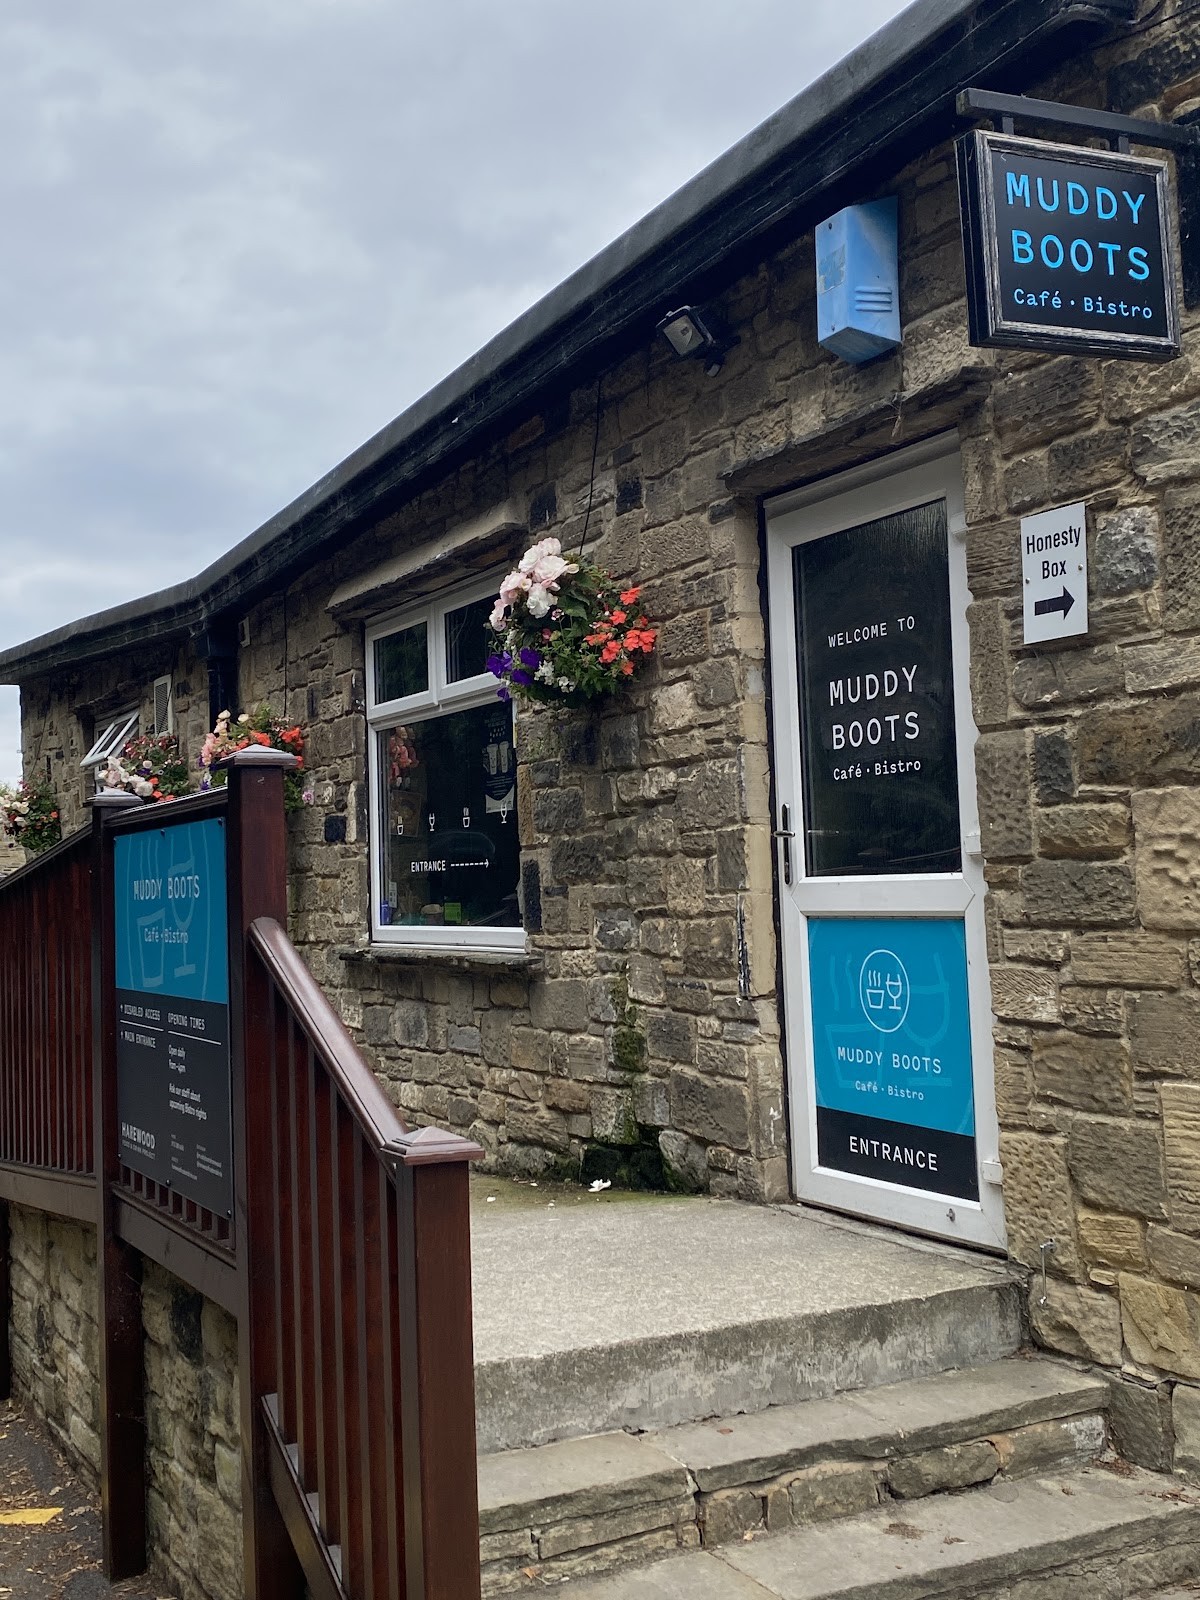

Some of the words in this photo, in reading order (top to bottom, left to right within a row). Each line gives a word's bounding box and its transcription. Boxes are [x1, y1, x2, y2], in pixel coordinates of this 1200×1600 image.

[1005, 171, 1145, 225] MUDDY
[1011, 229, 1150, 280] BOOTS
[1013, 288, 1062, 309] Café
[1084, 296, 1153, 319] Bistro
[1026, 525, 1081, 555] Honesty
[1042, 560, 1067, 580] Box
[828, 622, 888, 648] WELCOME
[897, 615, 915, 632] TO
[829, 664, 918, 706] MUDDY
[832, 711, 920, 750] BOOTS
[833, 763, 862, 781] Café
[874, 760, 921, 776] Bistro
[410, 859, 446, 873] ENTRANCE
[133, 878, 162, 901] MUDDY
[168, 875, 200, 899] BOOTS
[144, 926, 160, 943] Café
[164, 927, 189, 944] Bistro
[145, 1007, 161, 1022] ACCESS
[168, 1012, 188, 1028] OPENING
[189, 1016, 205, 1031] TIMES
[837, 1046, 883, 1066] MUDDY
[892, 1053, 942, 1075] BOOTS
[855, 1080, 878, 1094] Café
[887, 1085, 924, 1101] Bistro
[121, 1121, 156, 1149] HAREWOOD
[849, 1135, 938, 1171] ENTRANCE
